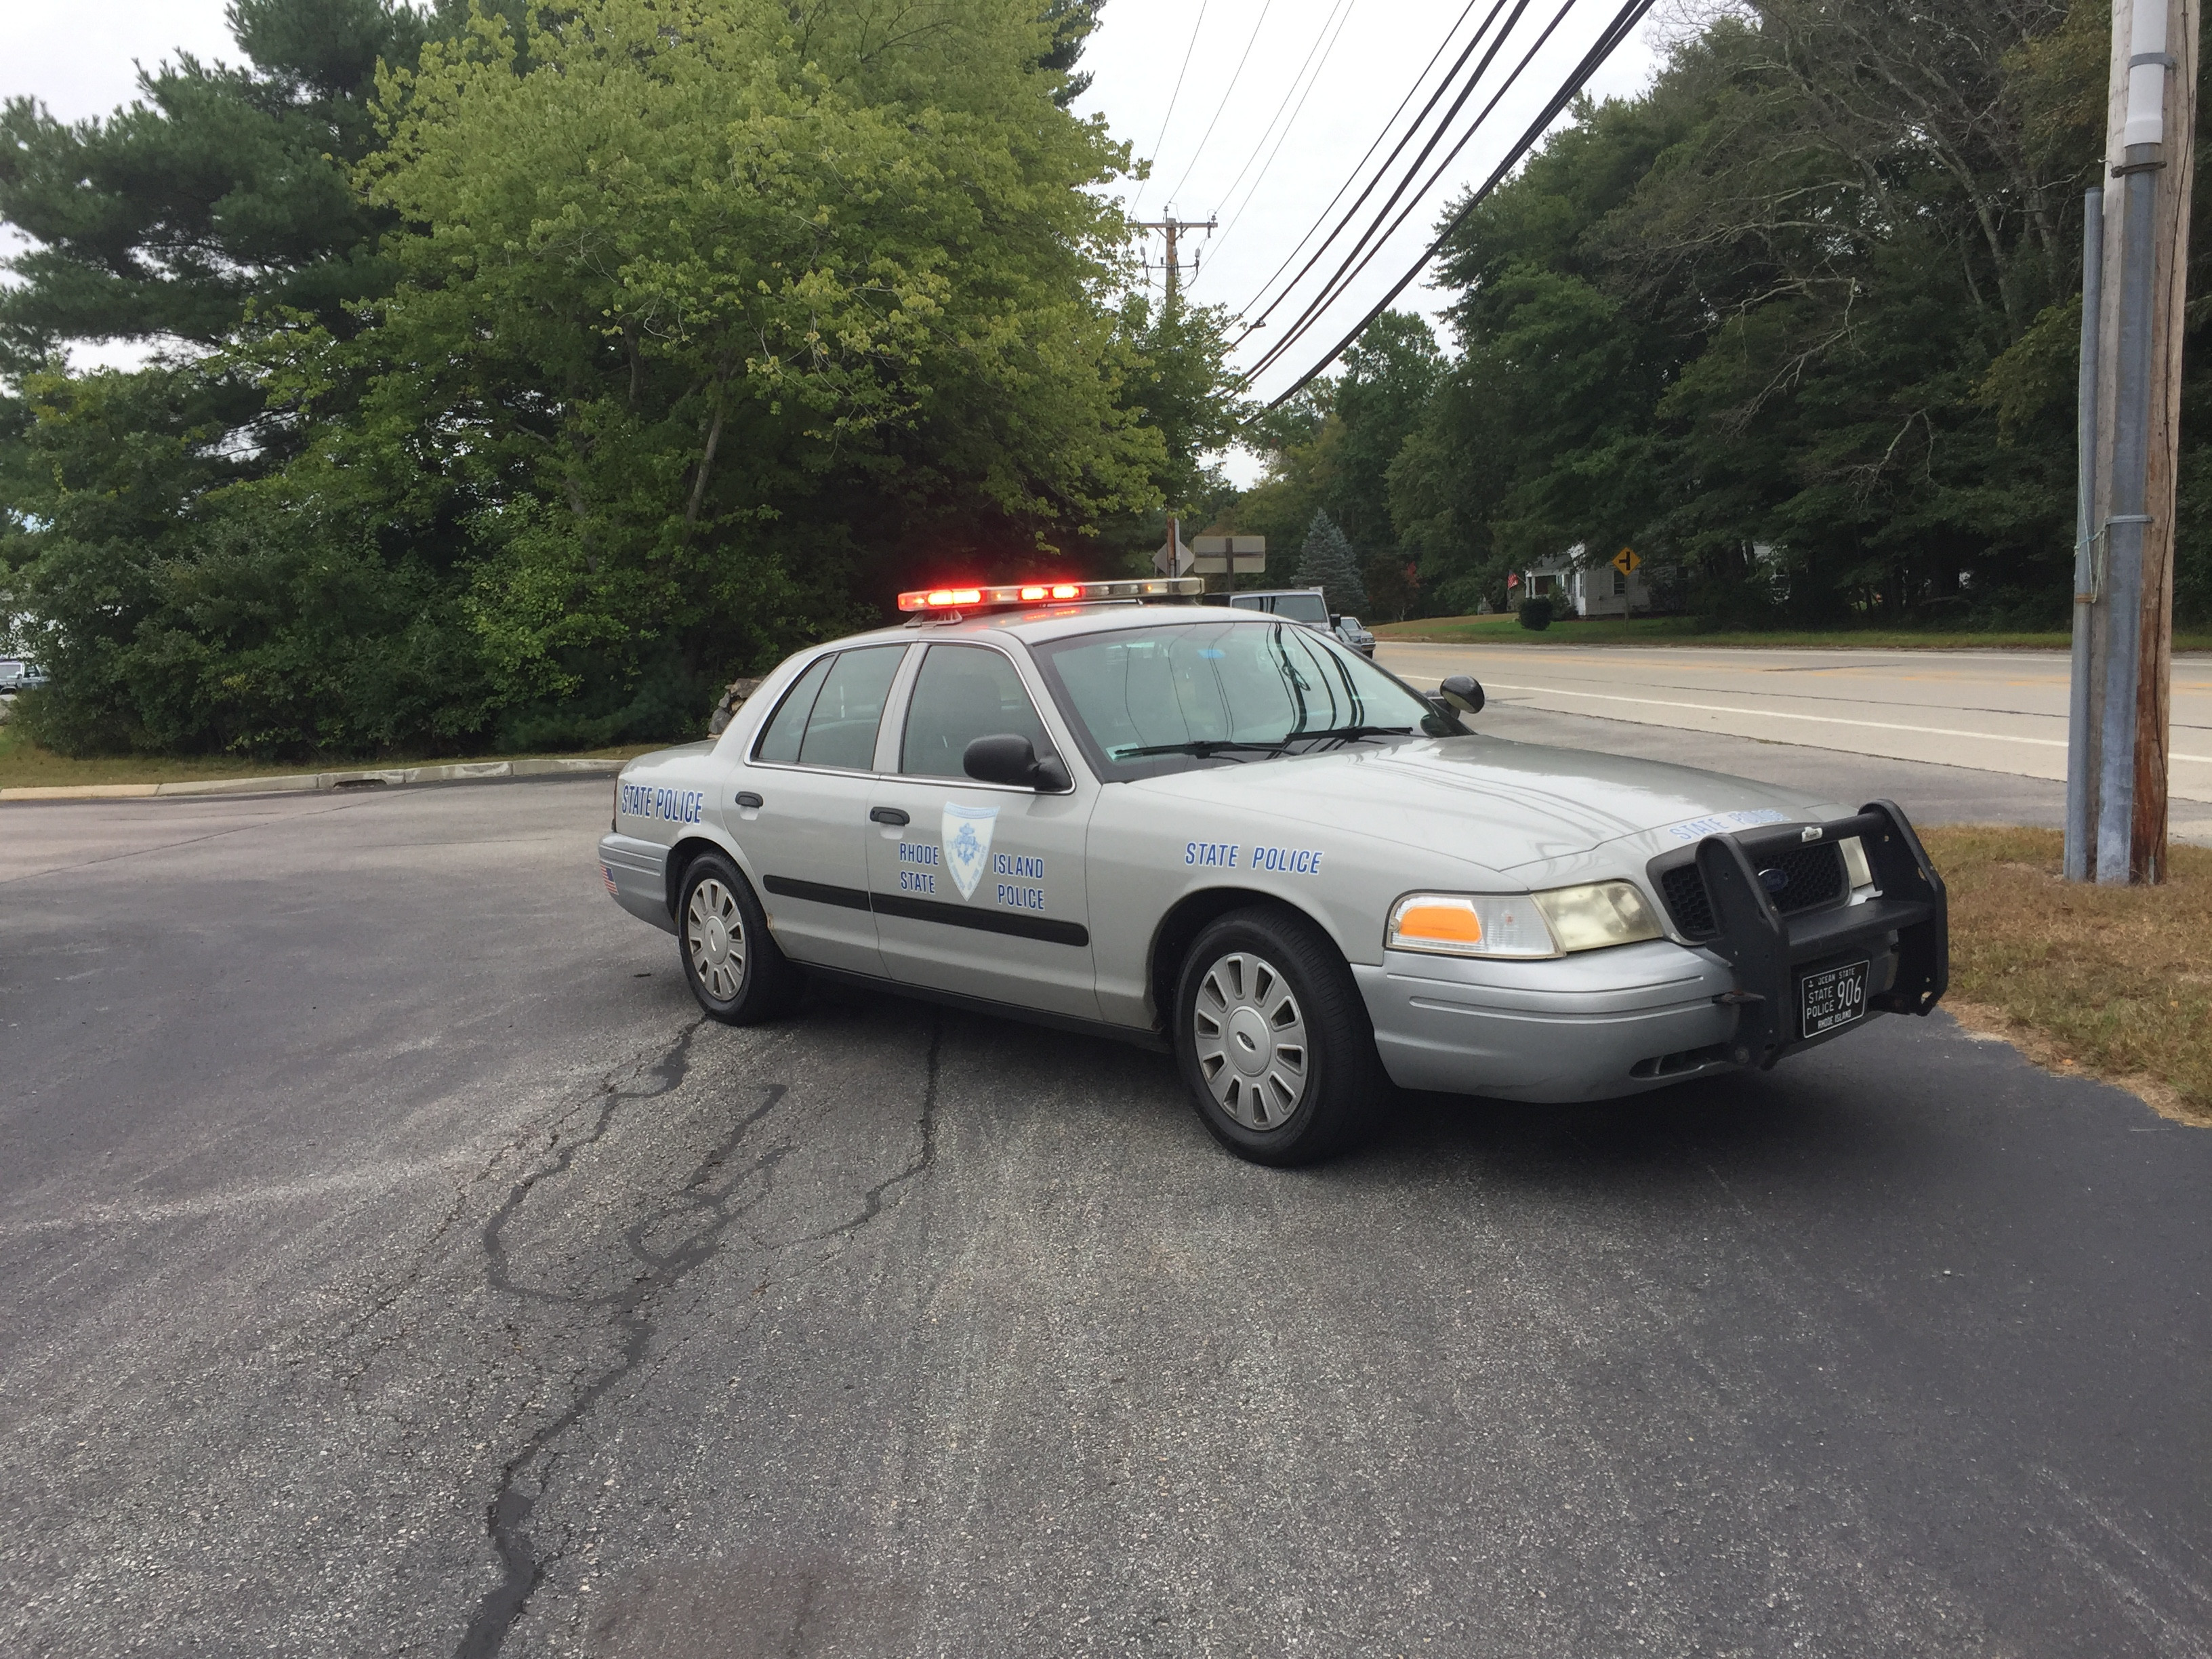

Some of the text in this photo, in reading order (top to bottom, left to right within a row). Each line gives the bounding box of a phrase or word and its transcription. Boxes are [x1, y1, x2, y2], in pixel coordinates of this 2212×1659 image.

[622, 785, 703, 824] STATE POLICE
[1669, 818, 1729, 840] STATE
[900, 843, 939, 865] RHODE
[994, 854, 1044, 879] ISLAND
[1185, 842, 1323, 874] STATE POLICE
[901, 872, 1044, 909] STATE POLICE
[1839, 967, 1856, 979] STATE
[1808, 986, 1833, 1004] STATE
[1837, 975, 1862, 1010] 906
[1807, 1000, 1835, 1019] POLICE
